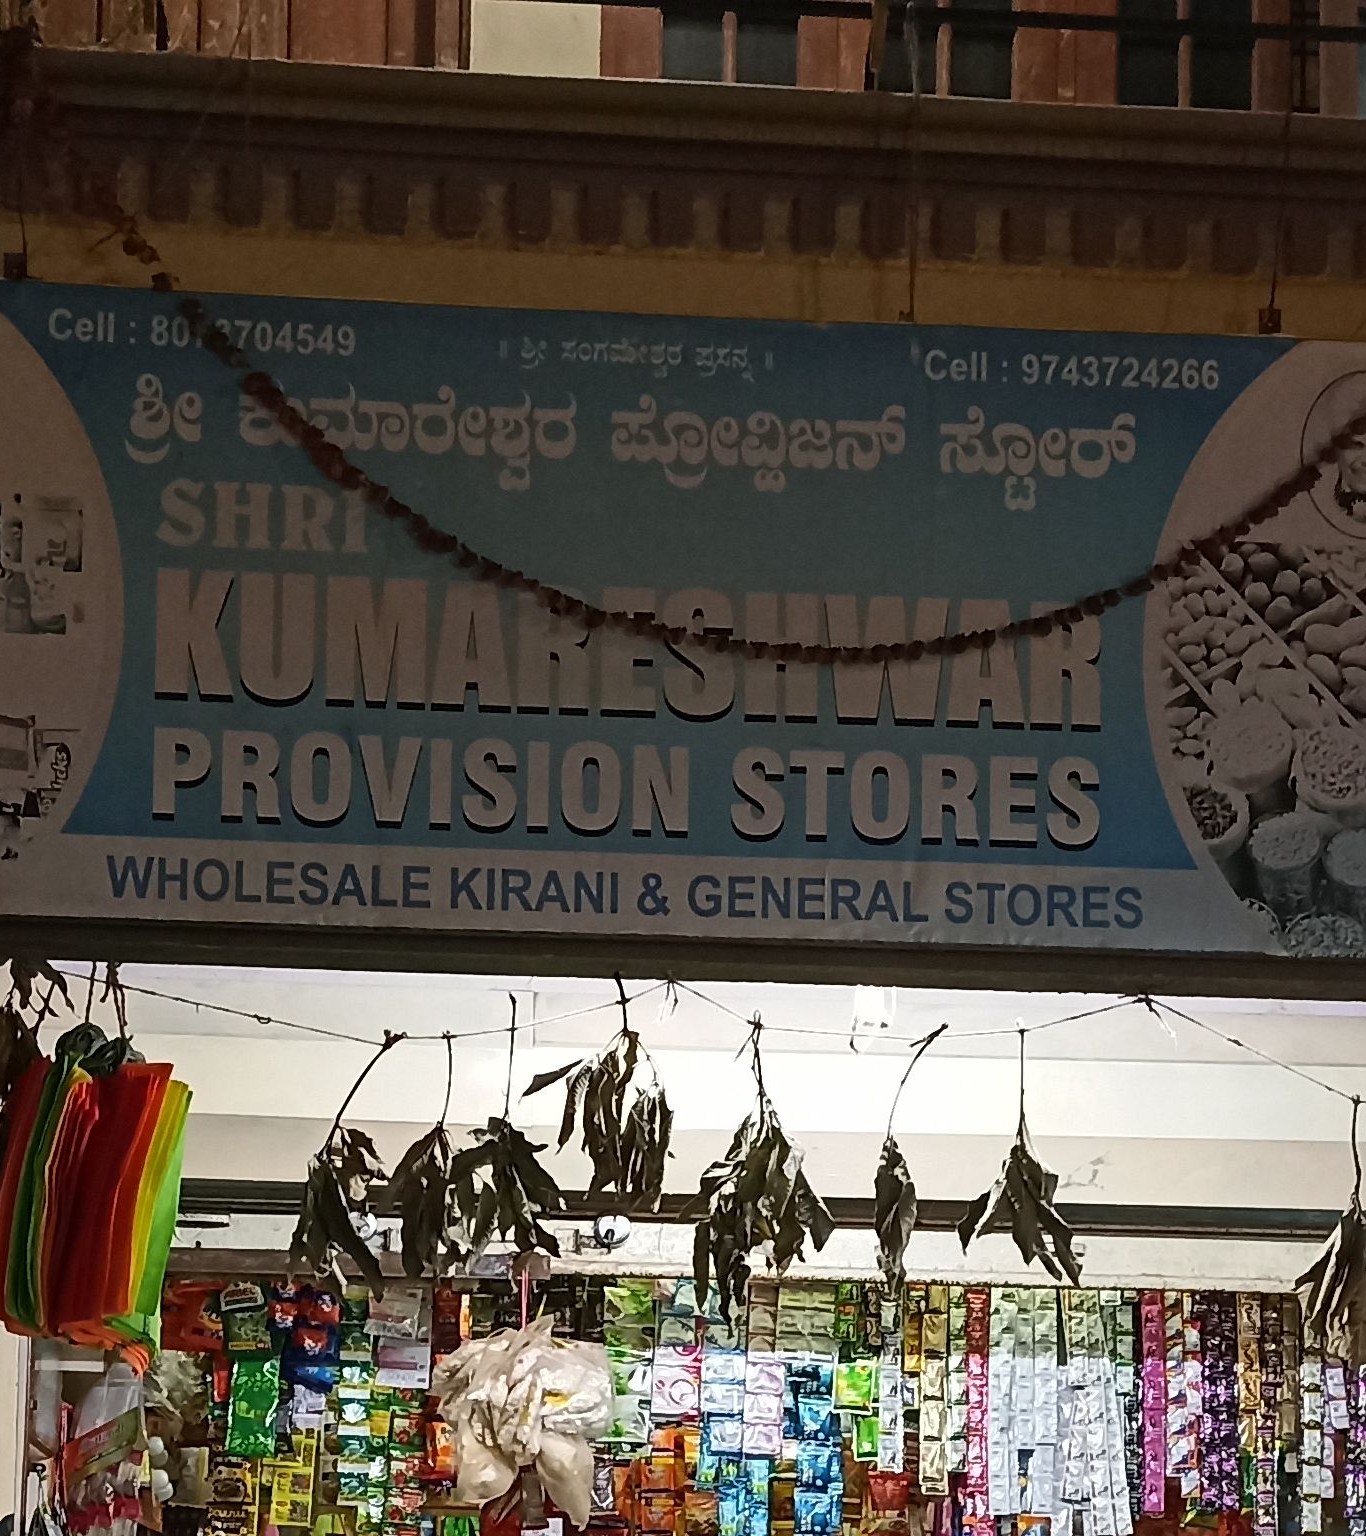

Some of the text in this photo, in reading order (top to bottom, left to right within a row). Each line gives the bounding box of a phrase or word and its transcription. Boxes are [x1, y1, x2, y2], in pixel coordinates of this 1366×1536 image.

[48, 308, 115, 343] Cell
[924, 350, 988, 384] Cell
[1021, 356, 1221, 392] 9743724266
[124, 373, 203, 463] ಶ್ರೀ
[940, 405, 1137, 511] ಸ್ಟೋರ್
[157, 478, 372, 554] SHRI
[154, 566, 1102, 733] KUMARESHWAR
[151, 727, 1102, 848] PROVISION STORES
[106, 854, 1144, 930] WHOLESALE KIRANI & GENERAL STORES
